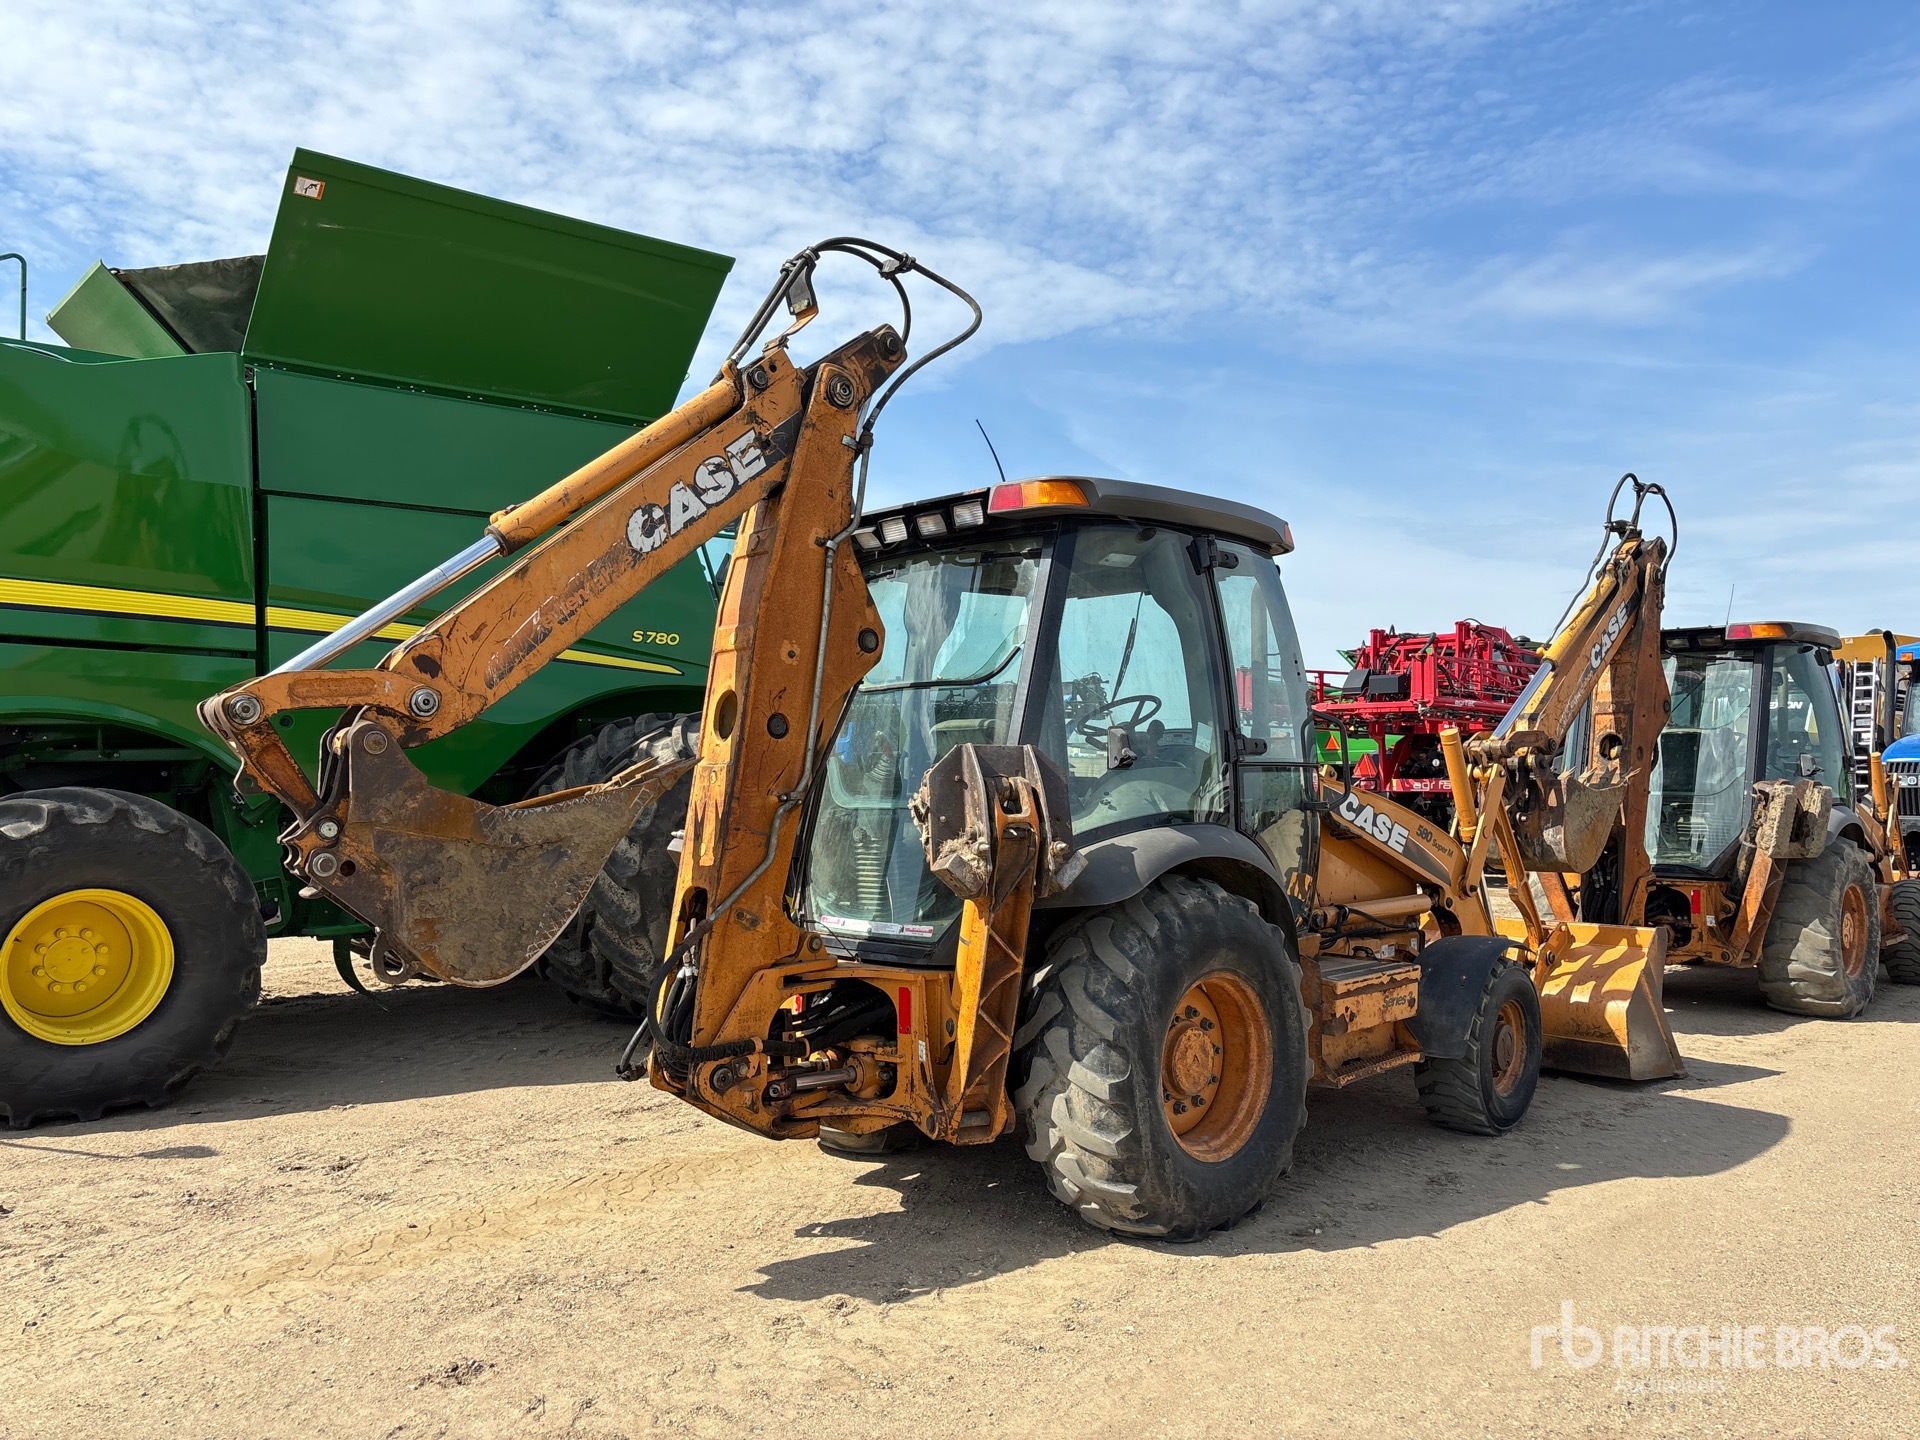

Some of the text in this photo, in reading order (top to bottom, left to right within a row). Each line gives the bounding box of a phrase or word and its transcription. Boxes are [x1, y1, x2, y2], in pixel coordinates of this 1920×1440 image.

[625, 427, 767, 553] CASE
[1590, 599, 1628, 669] CASE
[1339, 792, 1410, 854] CASE
[1416, 824, 1433, 842] 580
[1432, 839, 1448, 854] Super
[1382, 994, 1407, 1009] Series
